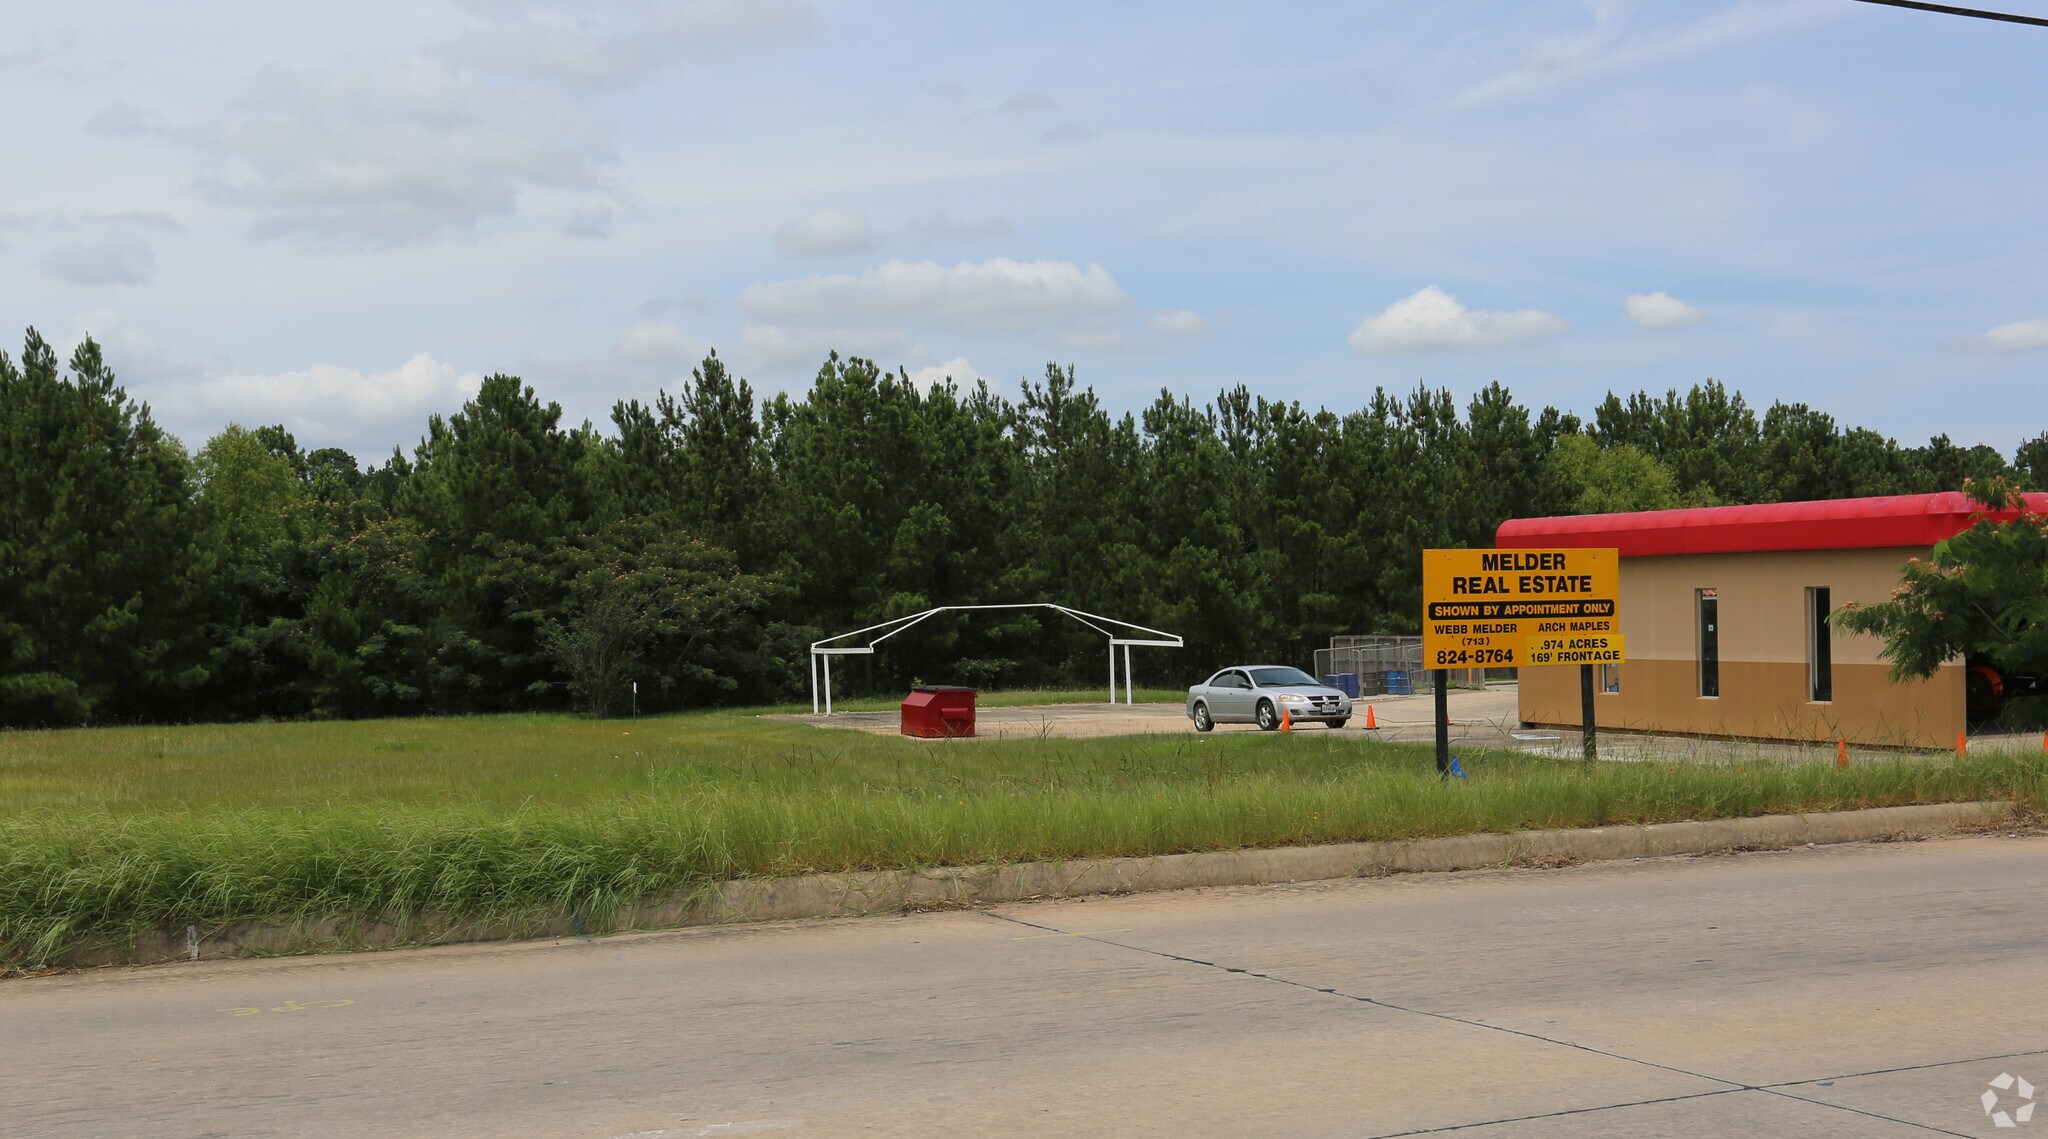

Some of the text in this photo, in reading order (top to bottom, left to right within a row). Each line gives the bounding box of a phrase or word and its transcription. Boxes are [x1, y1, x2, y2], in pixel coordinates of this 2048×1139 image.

[1482, 553, 1565, 570] MELDER
[1453, 576, 1591, 594] REAL ESTATE
[1435, 603, 1610, 617] SHOWN BY APPOINTMENT ONLY
[1434, 624, 1517, 634] WEBB MELDER
[1538, 621, 1609, 632] ARCH MAPLES
[1462, 637, 1489, 646] (713)
[1569, 638, 1608, 648] ACRES
[1437, 649, 1513, 664] 824-8764
[1531, 651, 1620, 662] 169' FRONTAGE
